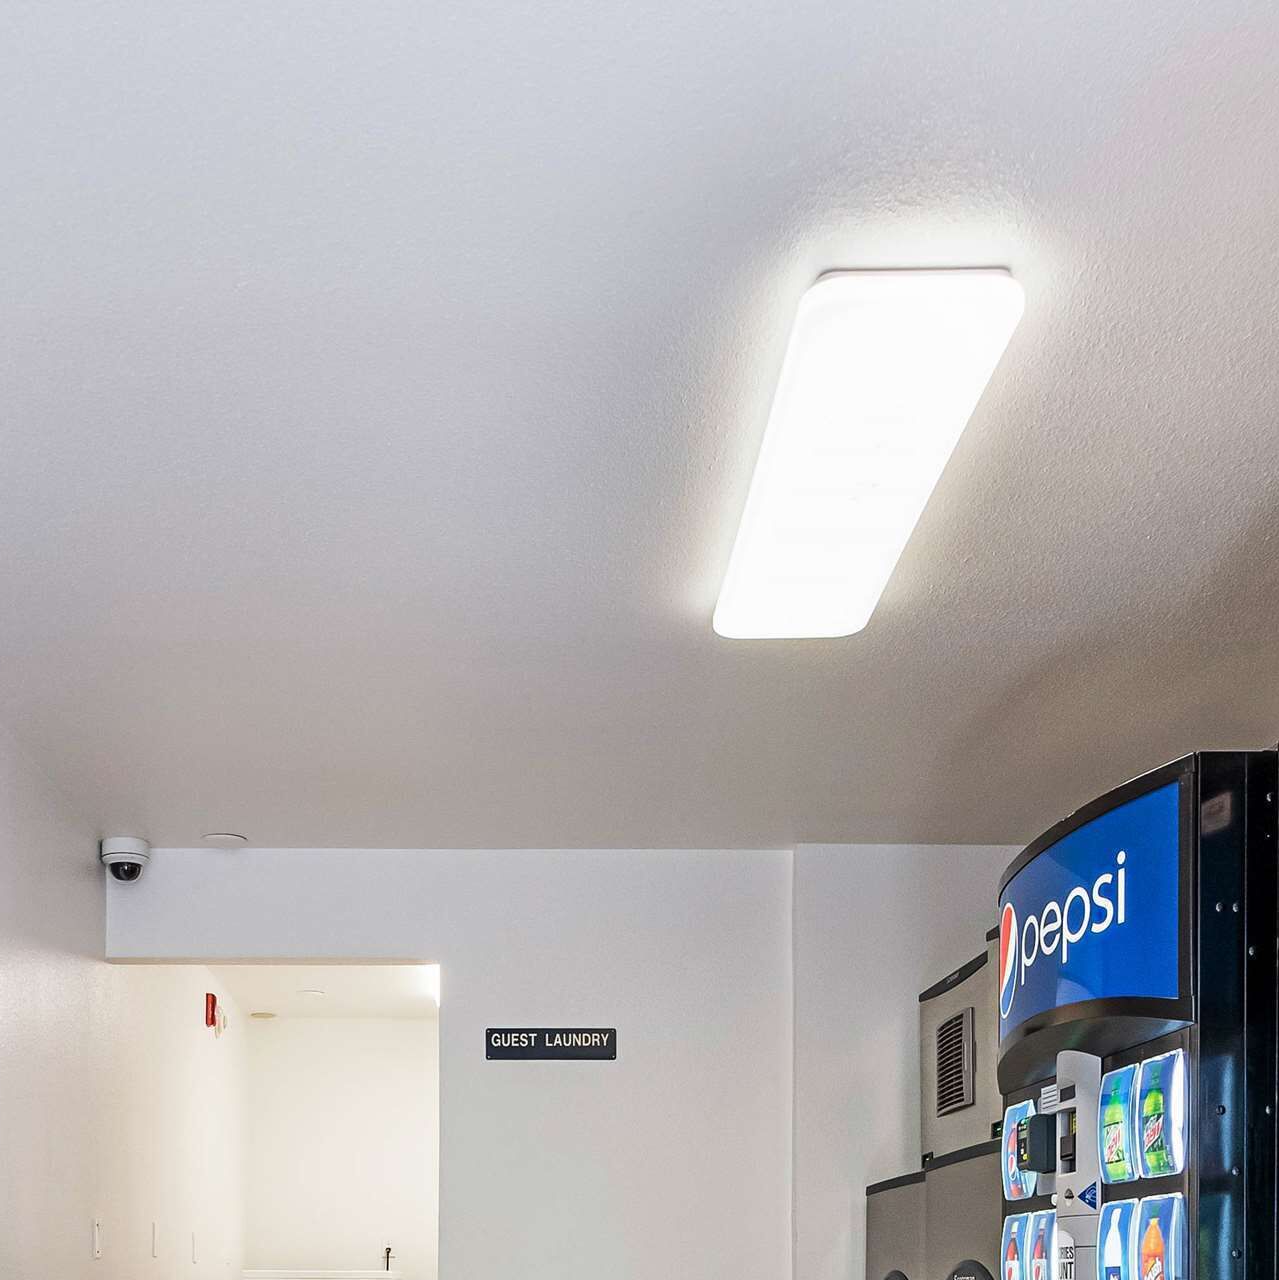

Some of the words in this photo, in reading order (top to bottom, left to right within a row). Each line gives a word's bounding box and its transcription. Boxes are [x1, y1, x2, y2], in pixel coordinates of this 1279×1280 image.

[1021, 850, 1126, 987] pepsi
[491, 1033, 537, 1047] GUEST
[545, 1033, 609, 1047] LAUNDRY
